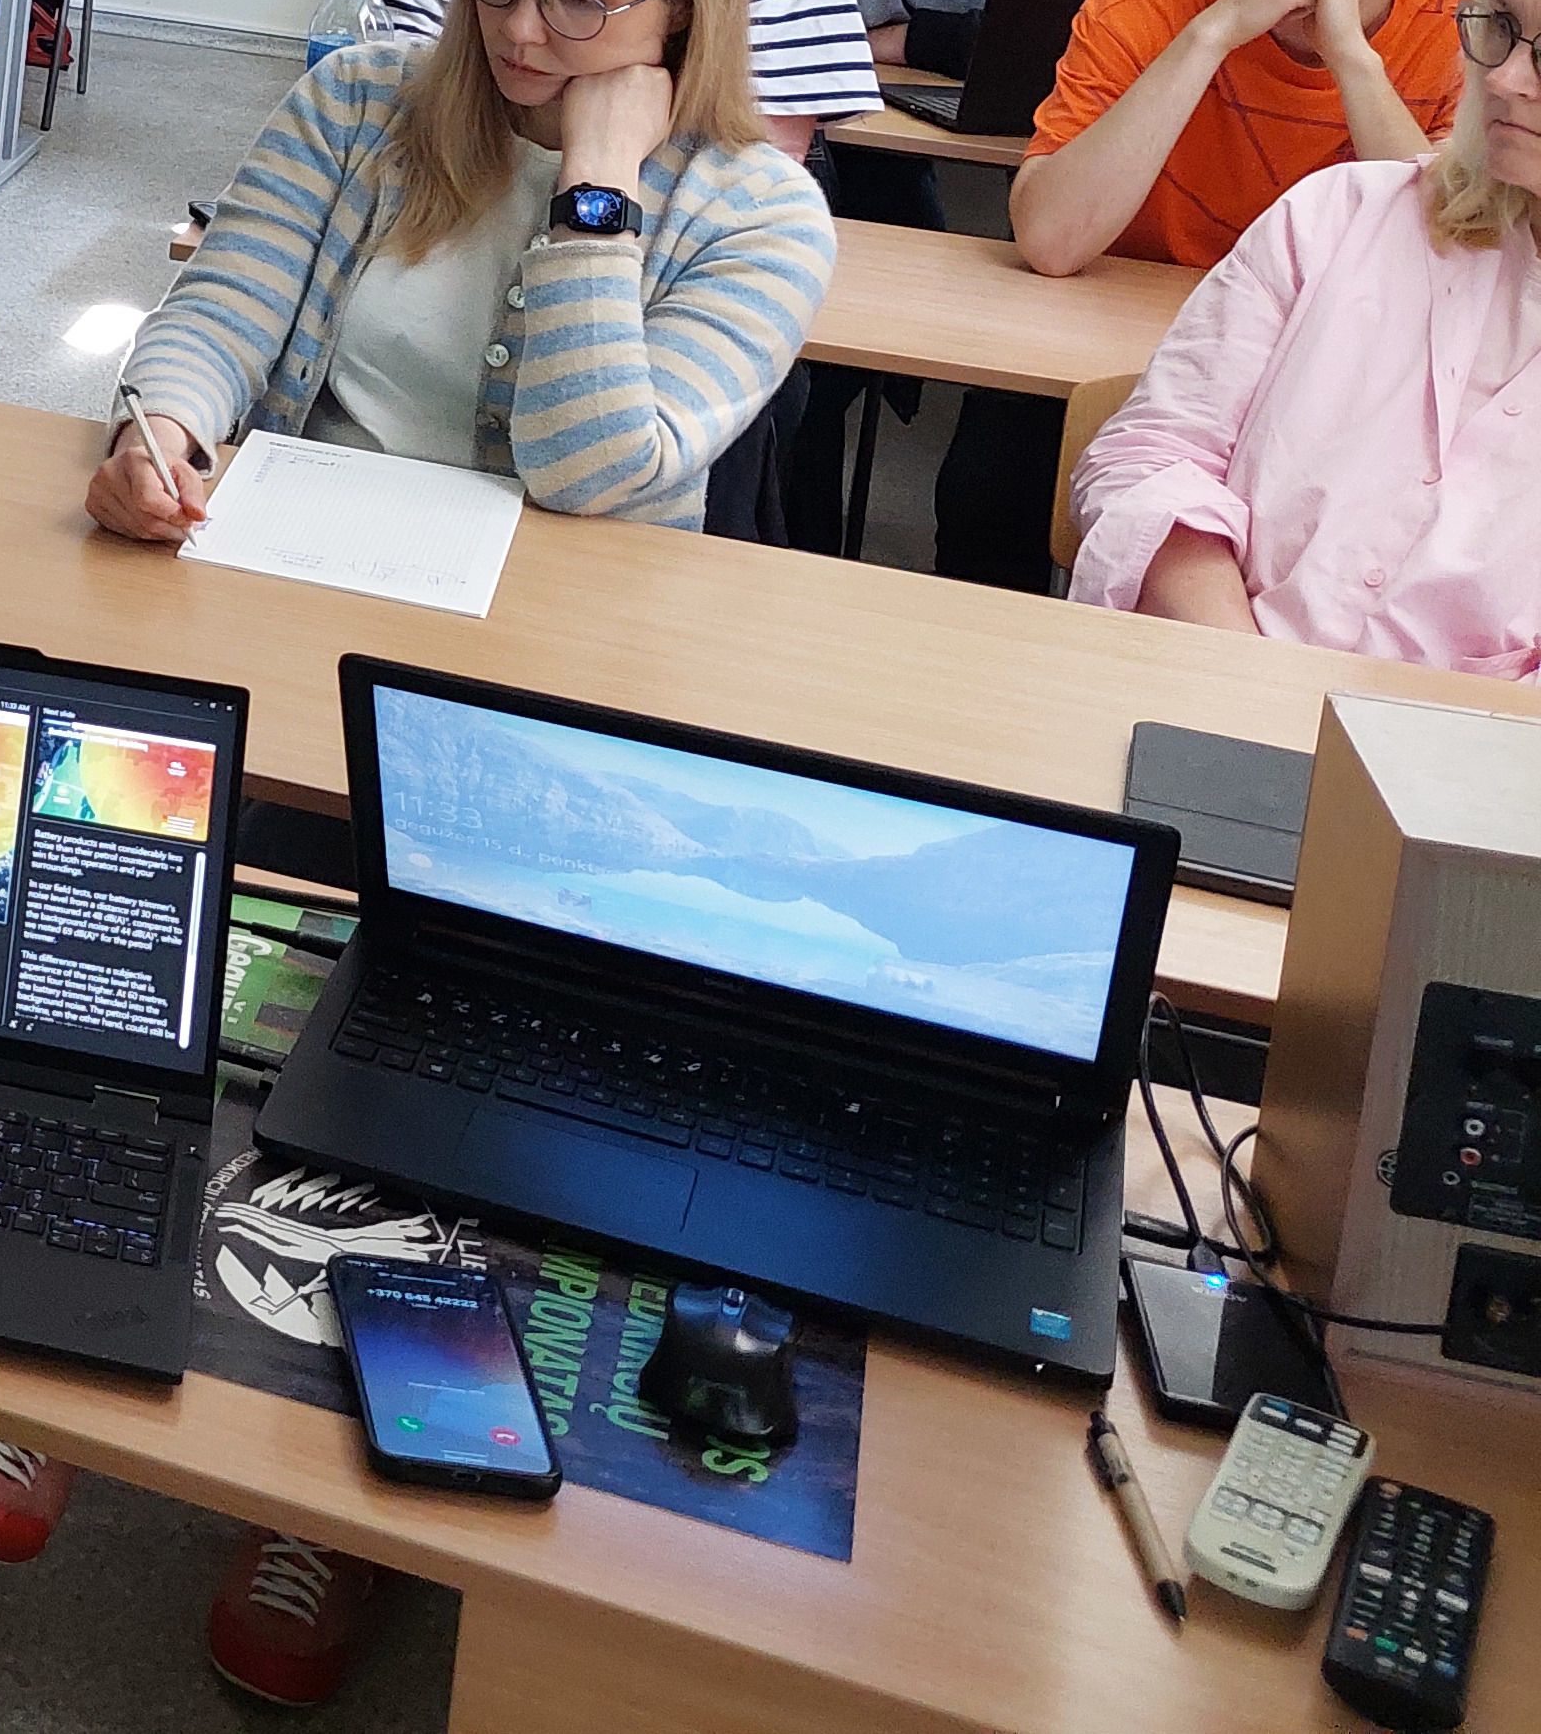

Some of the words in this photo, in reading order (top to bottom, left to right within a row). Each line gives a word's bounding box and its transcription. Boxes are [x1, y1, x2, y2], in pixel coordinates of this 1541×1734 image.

[33, 840, 54, 851] noise
[55, 843, 73, 854] than
[74, 847, 92, 857] their
[94, 850, 117, 863] petrol
[119, 855, 168, 872] counterparts
[35, 829, 61, 842] Battery
[63, 833, 97, 848] products
[98, 839, 116, 850] emit
[117, 843, 166, 860] considerably
[168, 851, 183, 861] less
[32, 849, 46, 859] win
[47, 852, 59, 862] for
[60, 854, 79, 865] both
[80, 858, 117, 873] operators
[119, 864, 134, 874] and
[136, 868, 155, 879] your
[28, 890, 48, 901] noise
[50, 893, 68, 904] level
[69, 897, 88, 907] from
[96, 901, 128, 914] distance
[130, 907, 139, 916] of
[152, 911, 179, 923] metres
[38, 882, 52, 890] our
[53, 883, 71, 894] field
[93, 891, 107, 900] our
[108, 893, 137, 907] battery
[25, 910, 39, 919] the
[40, 912, 86, 929] background
[88, 920, 109, 932] noise
[110, 924, 119, 933] of
[160, 933, 182, 944] while
[27, 901, 42, 910] was
[43, 903, 81, 917] measured
[82, 910, 90, 918] at
[132, 918, 172, 934] compared
[173, 925, 182, 934] to
[25, 922, 36, 930] we
[37, 923, 61, 934] noted
[100, 933, 112, 942] for
[113, 935, 126, 944] the
[128, 937, 152, 950] petrol
[20, 961, 61, 977] experience
[63, 968, 72, 977] of
[73, 970, 86, 980] the
[88, 973, 109, 984] noise
[110, 977, 129, 988] level
[130, 980, 146, 991] that
[148, 983, 154, 992] is
[21, 950, 37, 960] This
[38, 953, 77, 968] difference
[78, 962, 104, 973] means
[112, 967, 152, 983] subjective
[17, 981, 31, 991] the
[32, 983, 60, 998] battery
[62, 989, 93, 1002] trimmer
[94, 995, 127, 1009] blended
[128, 1001, 144, 1012] into
[145, 1005, 159, 1015] the
[19, 971, 45, 983] almost
[46, 976, 63, 986] four
[64, 979, 86, 991] times
[115, 989, 126, 998] At
[17, 991, 63, 1009] background
[89, 1004, 104, 1015] The
[51, 1010, 63, 1018] on
[64, 1011, 77, 1021] the
[79, 1013, 100, 1025] other
[124, 1022, 148, 1033] could
[149, 1026, 163, 1036] still
[164, 1029, 175, 1038] be
